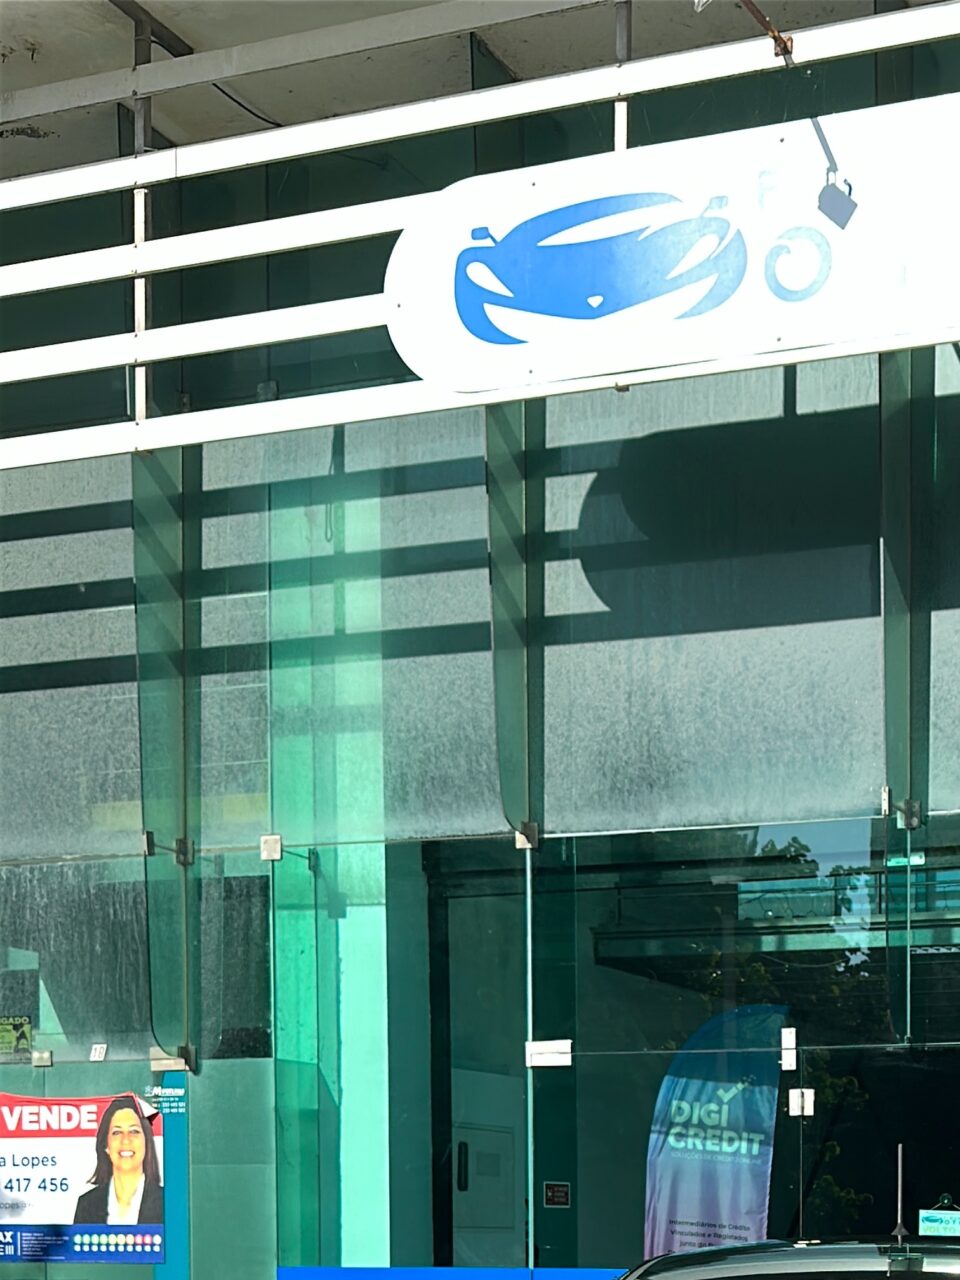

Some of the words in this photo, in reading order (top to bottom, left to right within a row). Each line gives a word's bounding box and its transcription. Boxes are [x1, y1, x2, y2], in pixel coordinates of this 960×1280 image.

[1, 1105, 98, 1131] VENDE
[671, 1100, 729, 1127] DIGI
[668, 1126, 765, 1155] CREDIT
[12, 1154, 57, 1170] Lopes
[4, 1178, 31, 1192] 417
[38, 1178, 69, 1192] 456
